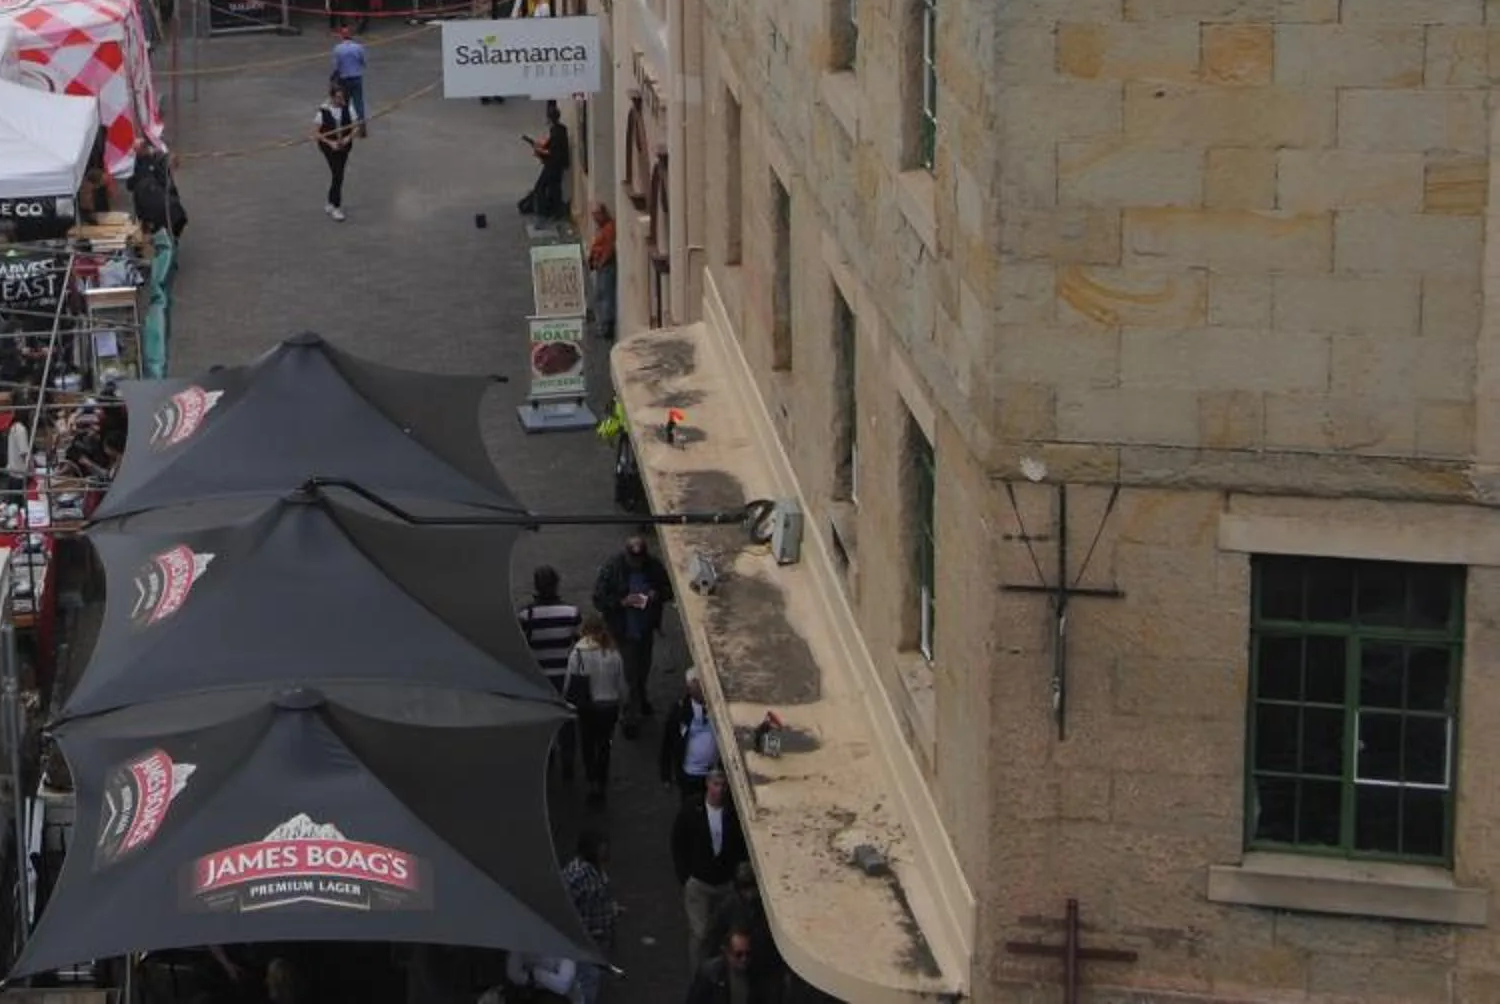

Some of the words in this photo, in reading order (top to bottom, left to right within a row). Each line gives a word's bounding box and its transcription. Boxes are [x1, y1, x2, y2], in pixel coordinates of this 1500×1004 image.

[455, 42, 587, 65] Salamanca
[534, 329, 581, 341] ROAST
[203, 846, 298, 886] JAMES
[307, 846, 408, 879] BOAG'S
[250, 880, 314, 897] PREMIUM
[319, 881, 361, 895] LAGER
